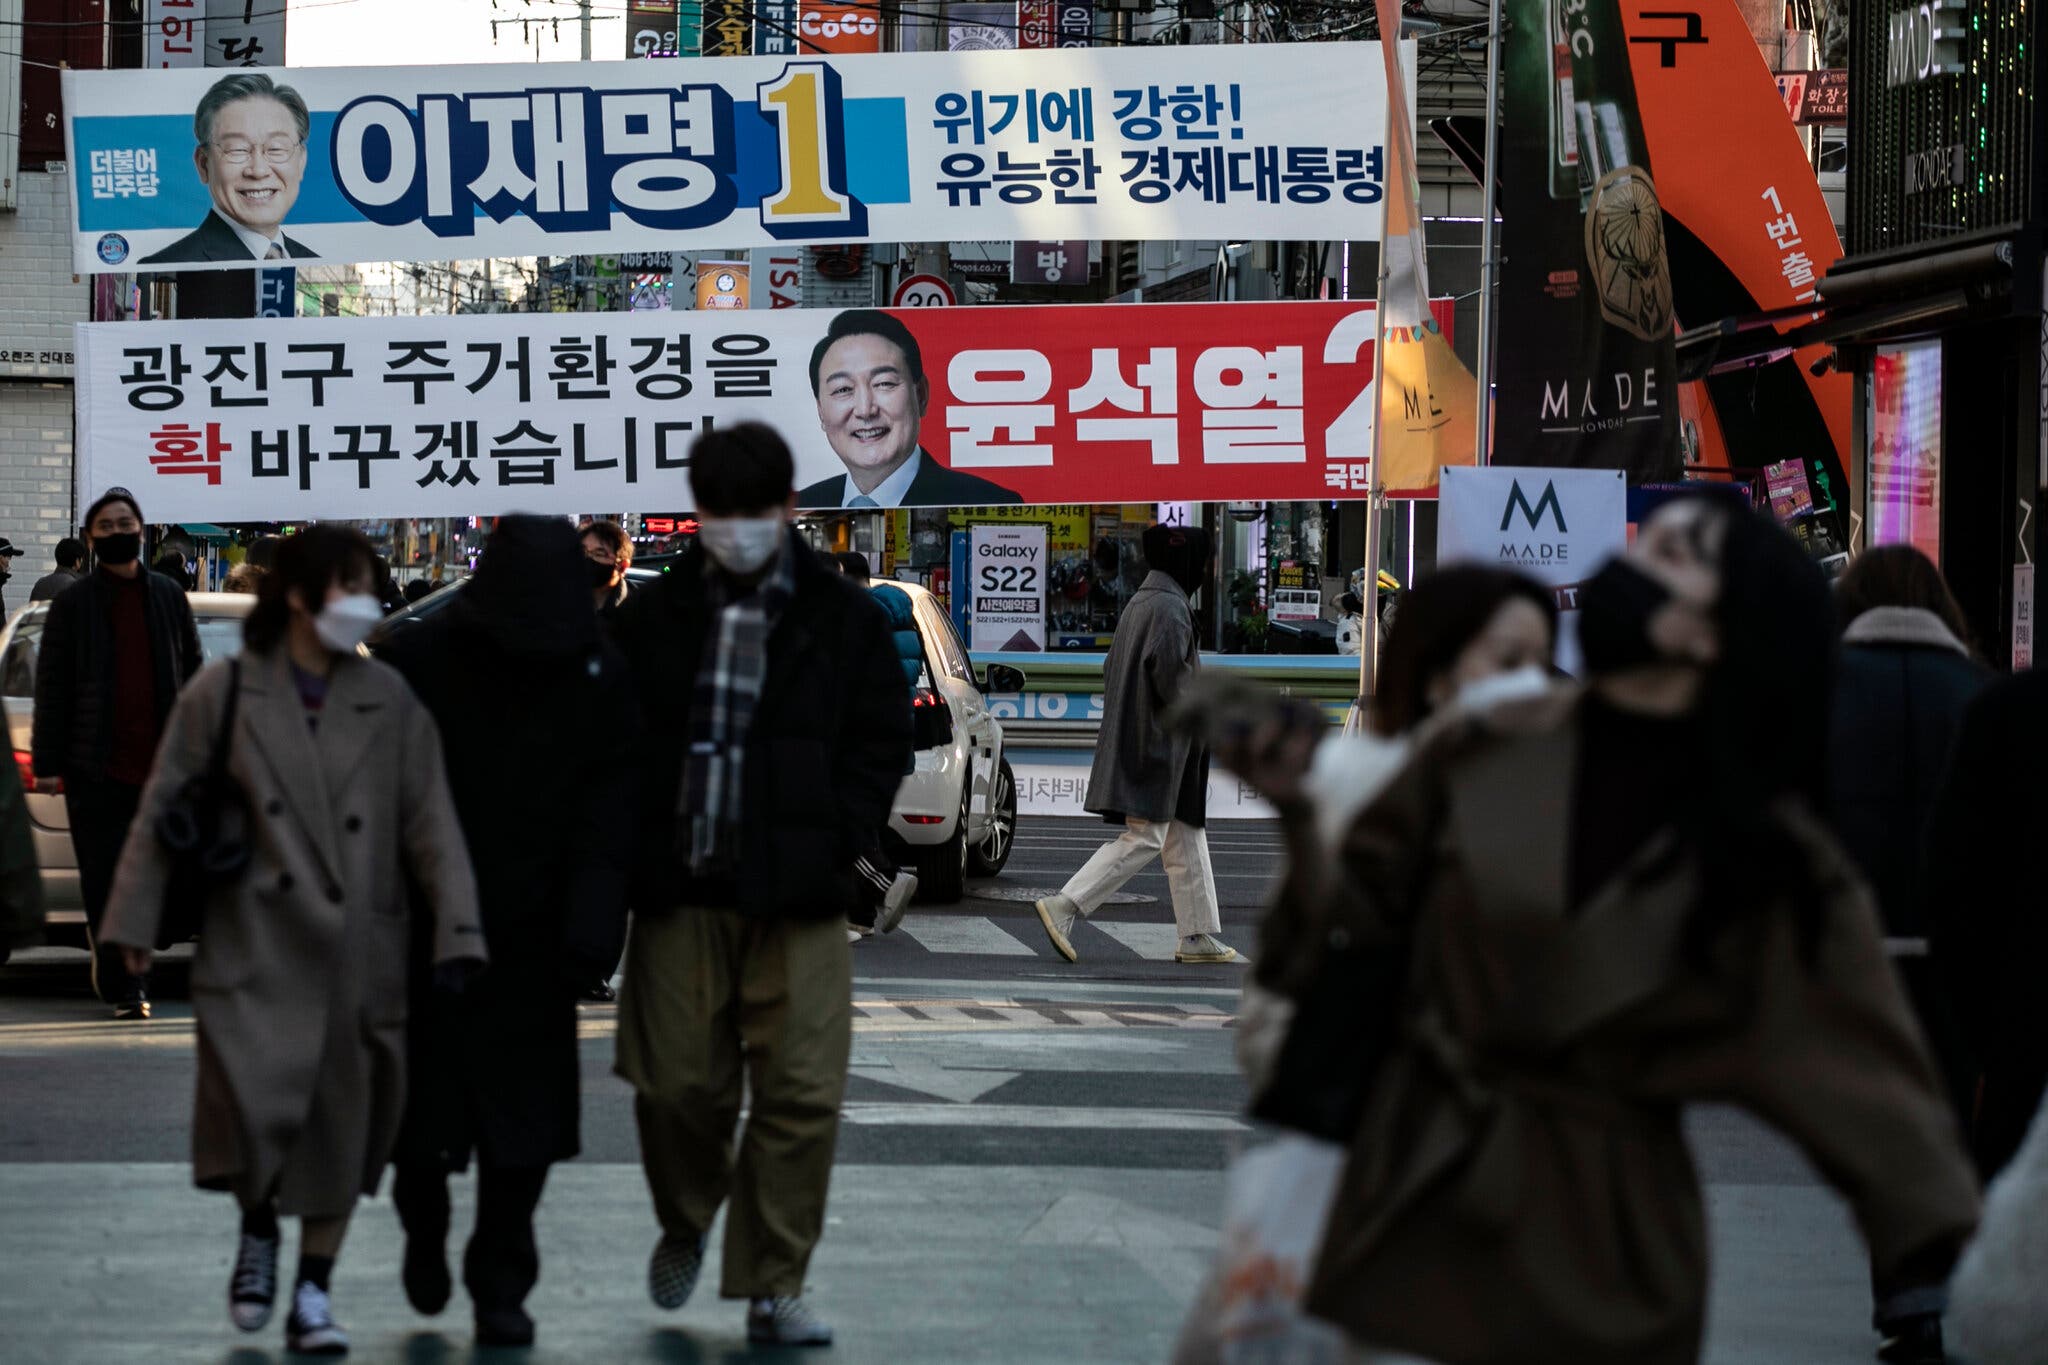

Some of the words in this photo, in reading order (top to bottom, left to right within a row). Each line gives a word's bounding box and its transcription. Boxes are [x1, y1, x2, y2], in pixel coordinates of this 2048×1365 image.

[1630, 12, 1709, 67] 구
[1887, 0, 1966, 87] MADE
[933, 88, 1095, 145] 위기에
[1113, 84, 1245, 140] 강한!
[1812, 105, 1847, 113] TOILE
[90, 148, 157, 173] 더불어
[332, 84, 728, 230] 이재명
[757, 62, 862, 236] 1
[1912, 147, 1953, 192] KONDAE
[92, 173, 160, 199] 민주당
[937, 147, 1101, 206] 유능한
[1120, 146, 1384, 204] 경제대통령
[1037, 241, 1067, 282] 방
[0, 351, 35, 363] 오렌즈
[40, 351, 74, 365] 건대점
[120, 342, 353, 410] 광진구
[383, 333, 777, 404] 주거환경을
[946, 344, 1306, 468] 윤석열
[1324, 309, 1377, 459] 2
[1541, 367, 1658, 420] MADE
[149, 422, 232, 485] 확
[1325, 464, 1370, 490] 국민
[978, 543, 1039, 562] Galaxy
[1500, 543, 1568, 559] MADE
[980, 566, 1037, 592] S22
[1554, 587, 1578, 609] IT
[980, 598, 1038, 612] 사전예약중
